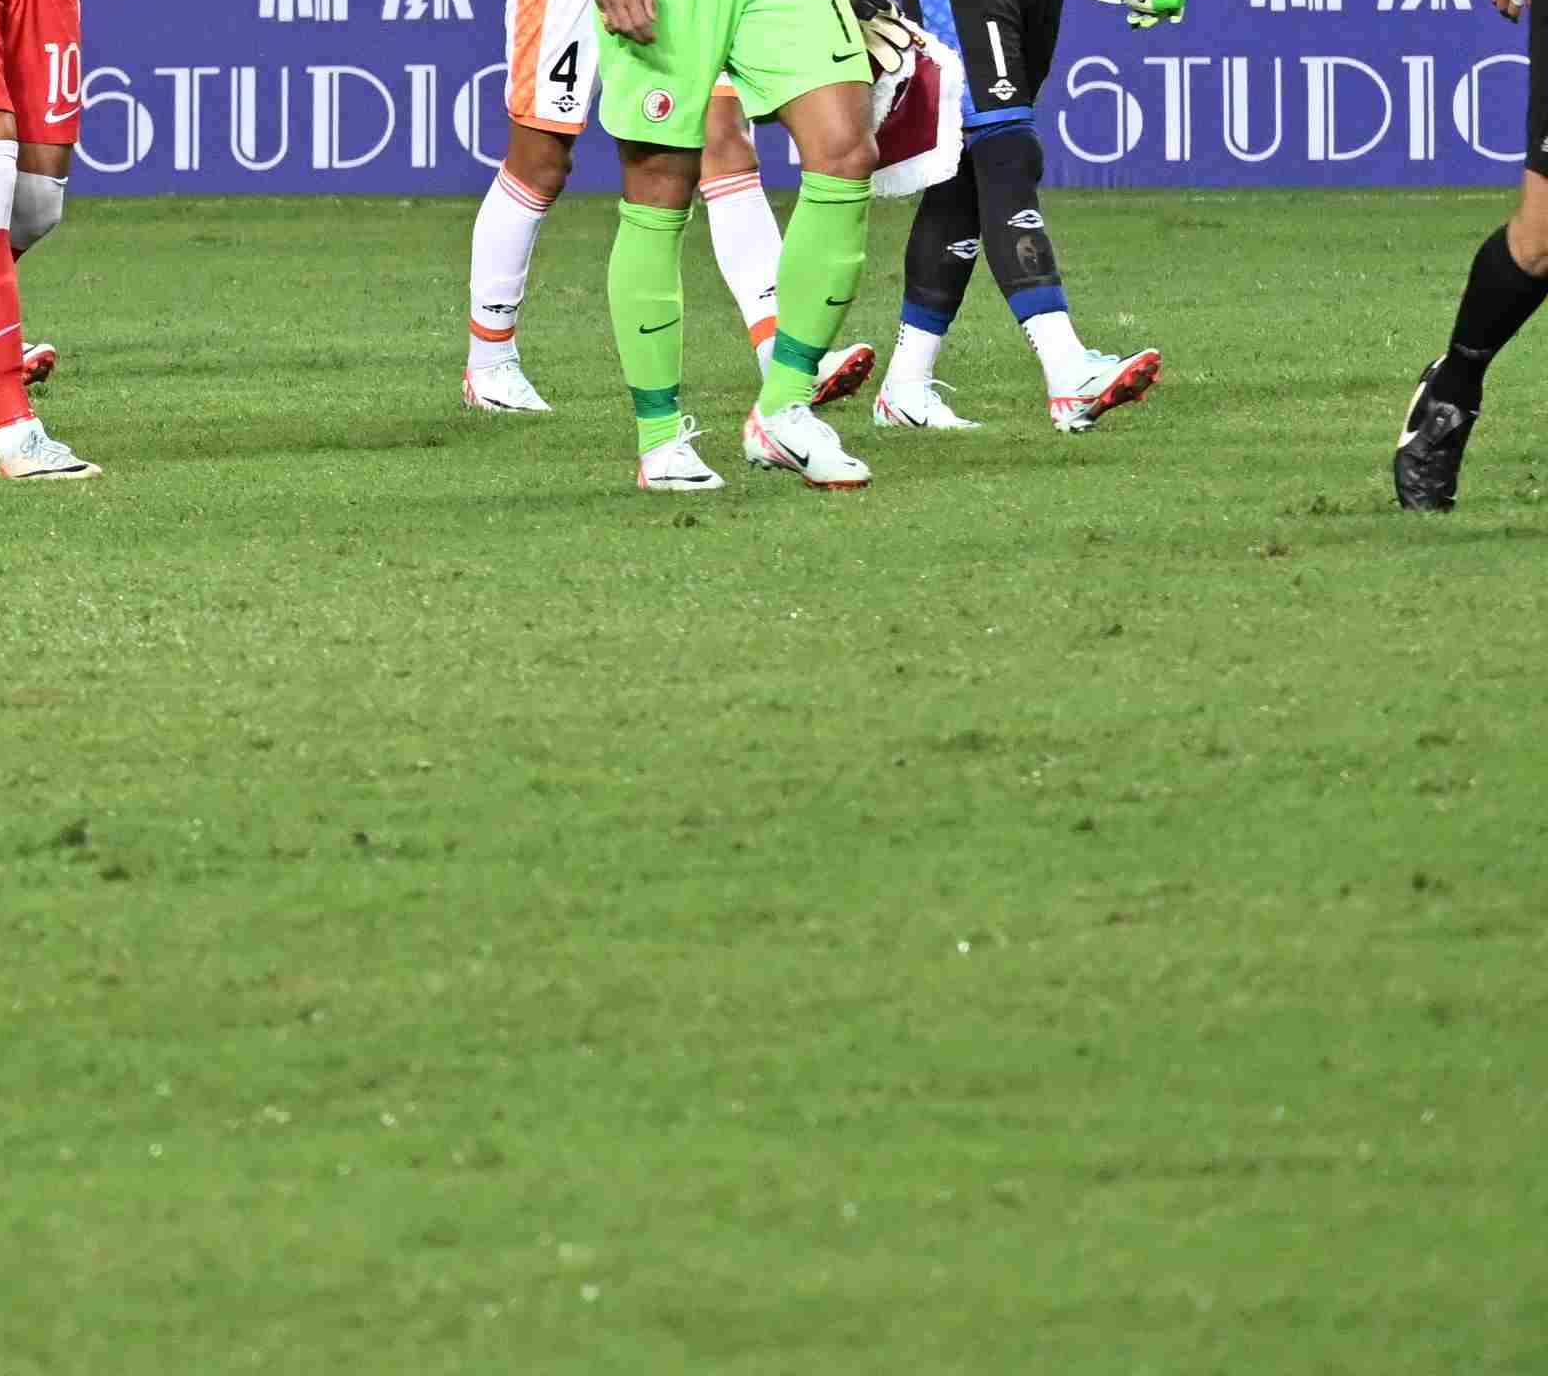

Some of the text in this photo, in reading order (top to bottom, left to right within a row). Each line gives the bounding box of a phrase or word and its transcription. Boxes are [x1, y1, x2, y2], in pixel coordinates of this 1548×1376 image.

[45, 43, 80, 104] 10
[550, 41, 578, 91] 4
[987, 21, 1007, 77] 1
